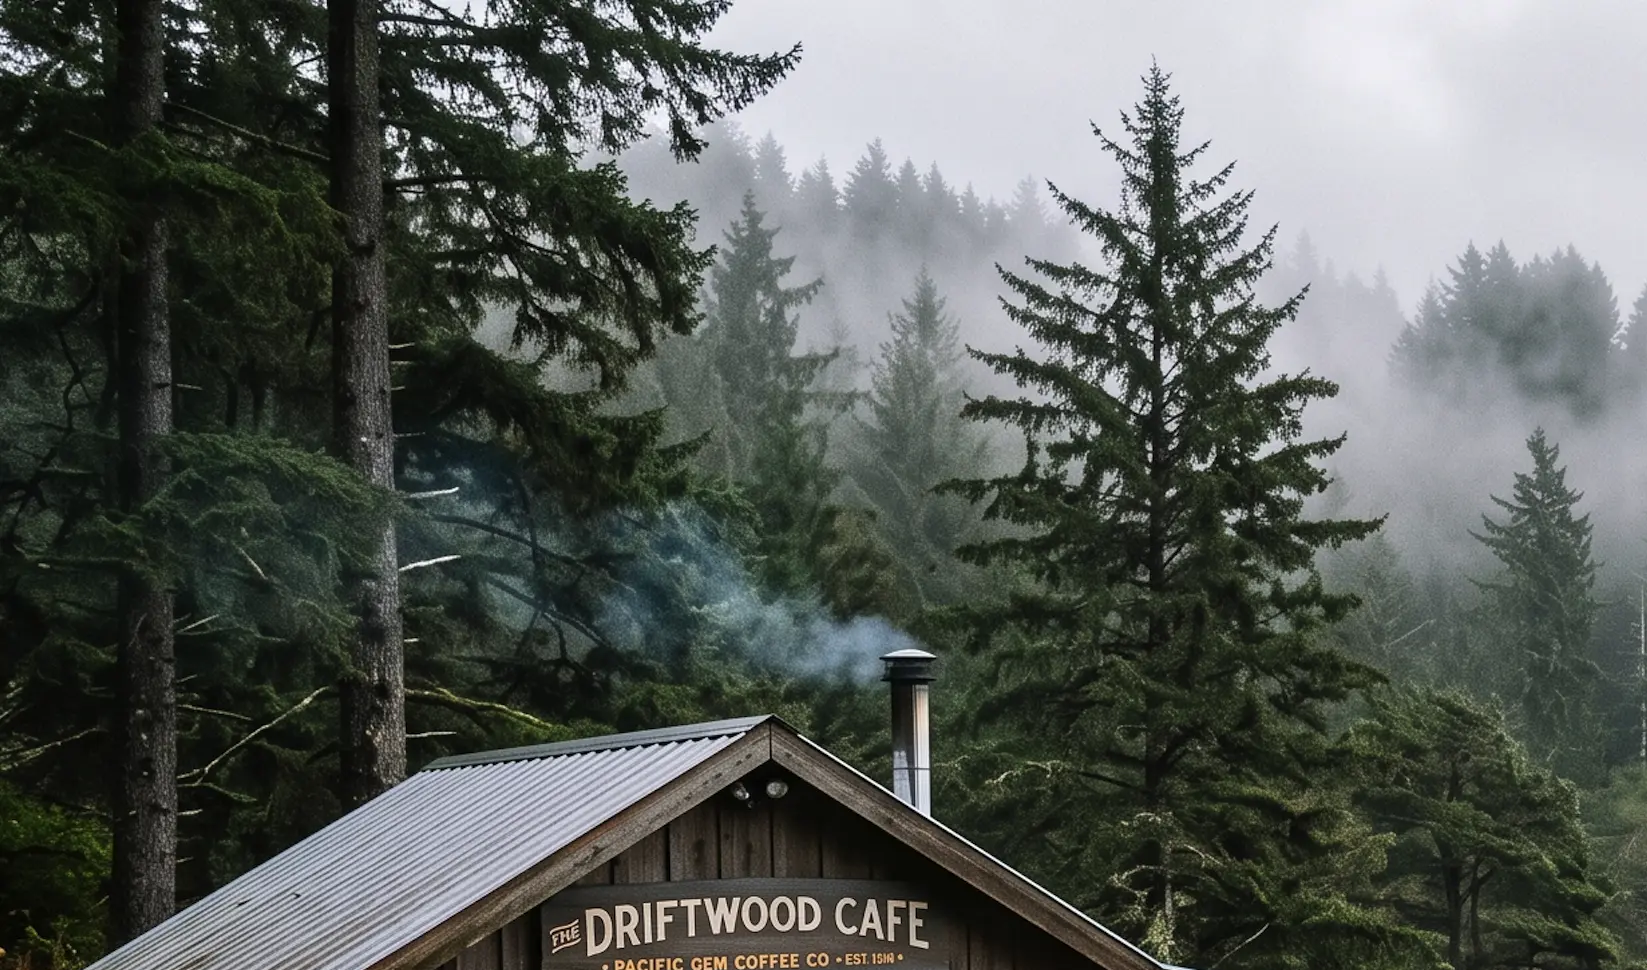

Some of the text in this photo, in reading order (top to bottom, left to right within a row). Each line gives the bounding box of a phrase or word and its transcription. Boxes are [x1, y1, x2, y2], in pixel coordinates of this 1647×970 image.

[585, 896, 822, 957] DRIFTWOOD
[834, 897, 930, 949] CAFE
[734, 953, 800, 970] COFFEE
[806, 952, 830, 968] CO
